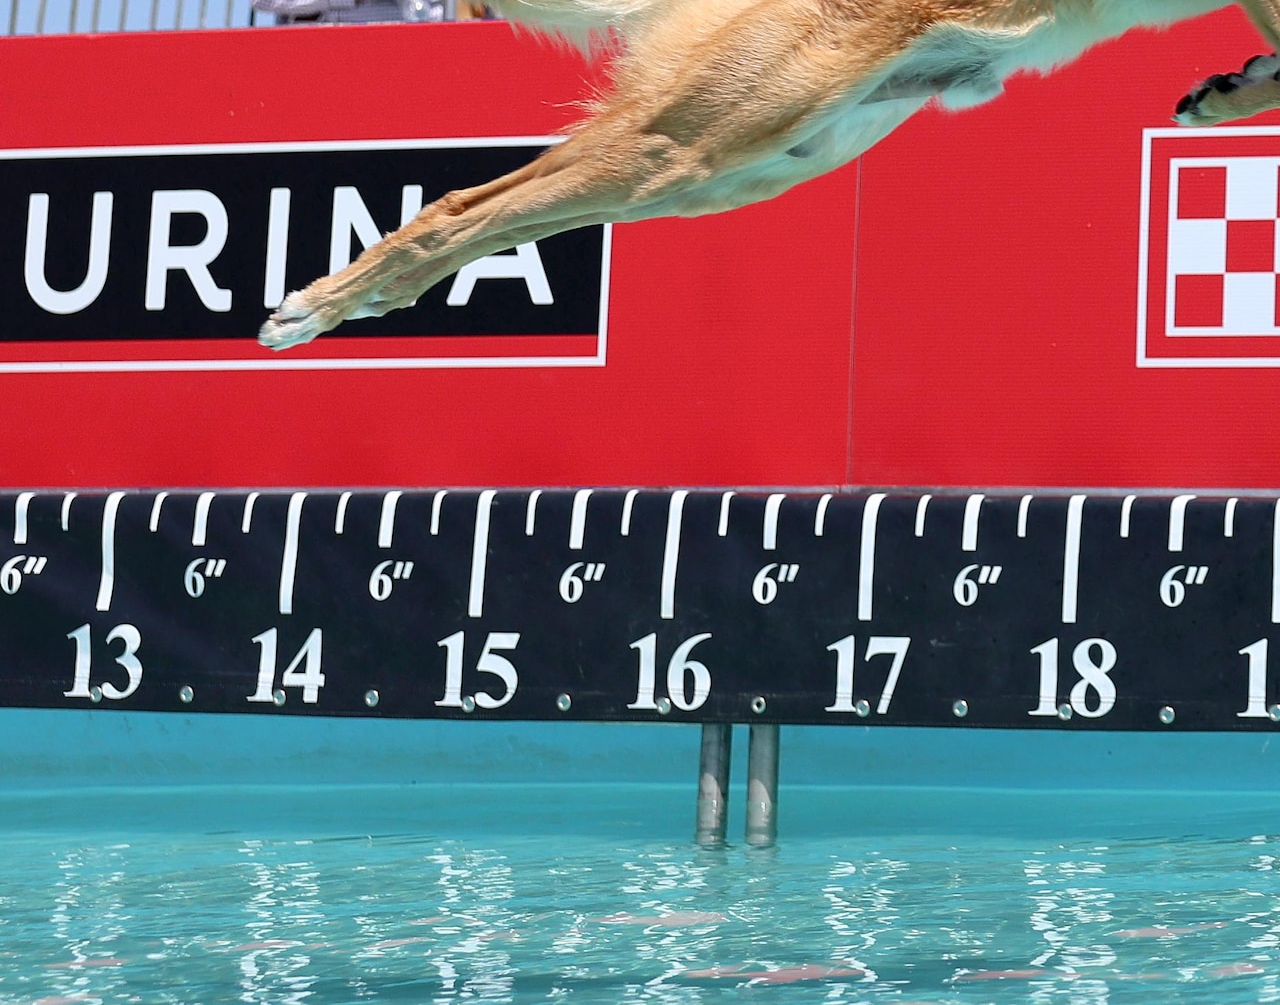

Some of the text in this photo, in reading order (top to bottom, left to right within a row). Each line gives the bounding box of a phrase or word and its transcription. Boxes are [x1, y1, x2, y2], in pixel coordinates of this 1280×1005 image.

[64, 624, 142, 700] 13
[246, 627, 325, 704] 14
[434, 631, 520, 709] 15
[626, 633, 711, 711] 16
[824, 635, 910, 715] 17
[1027, 638, 1117, 718] 18
